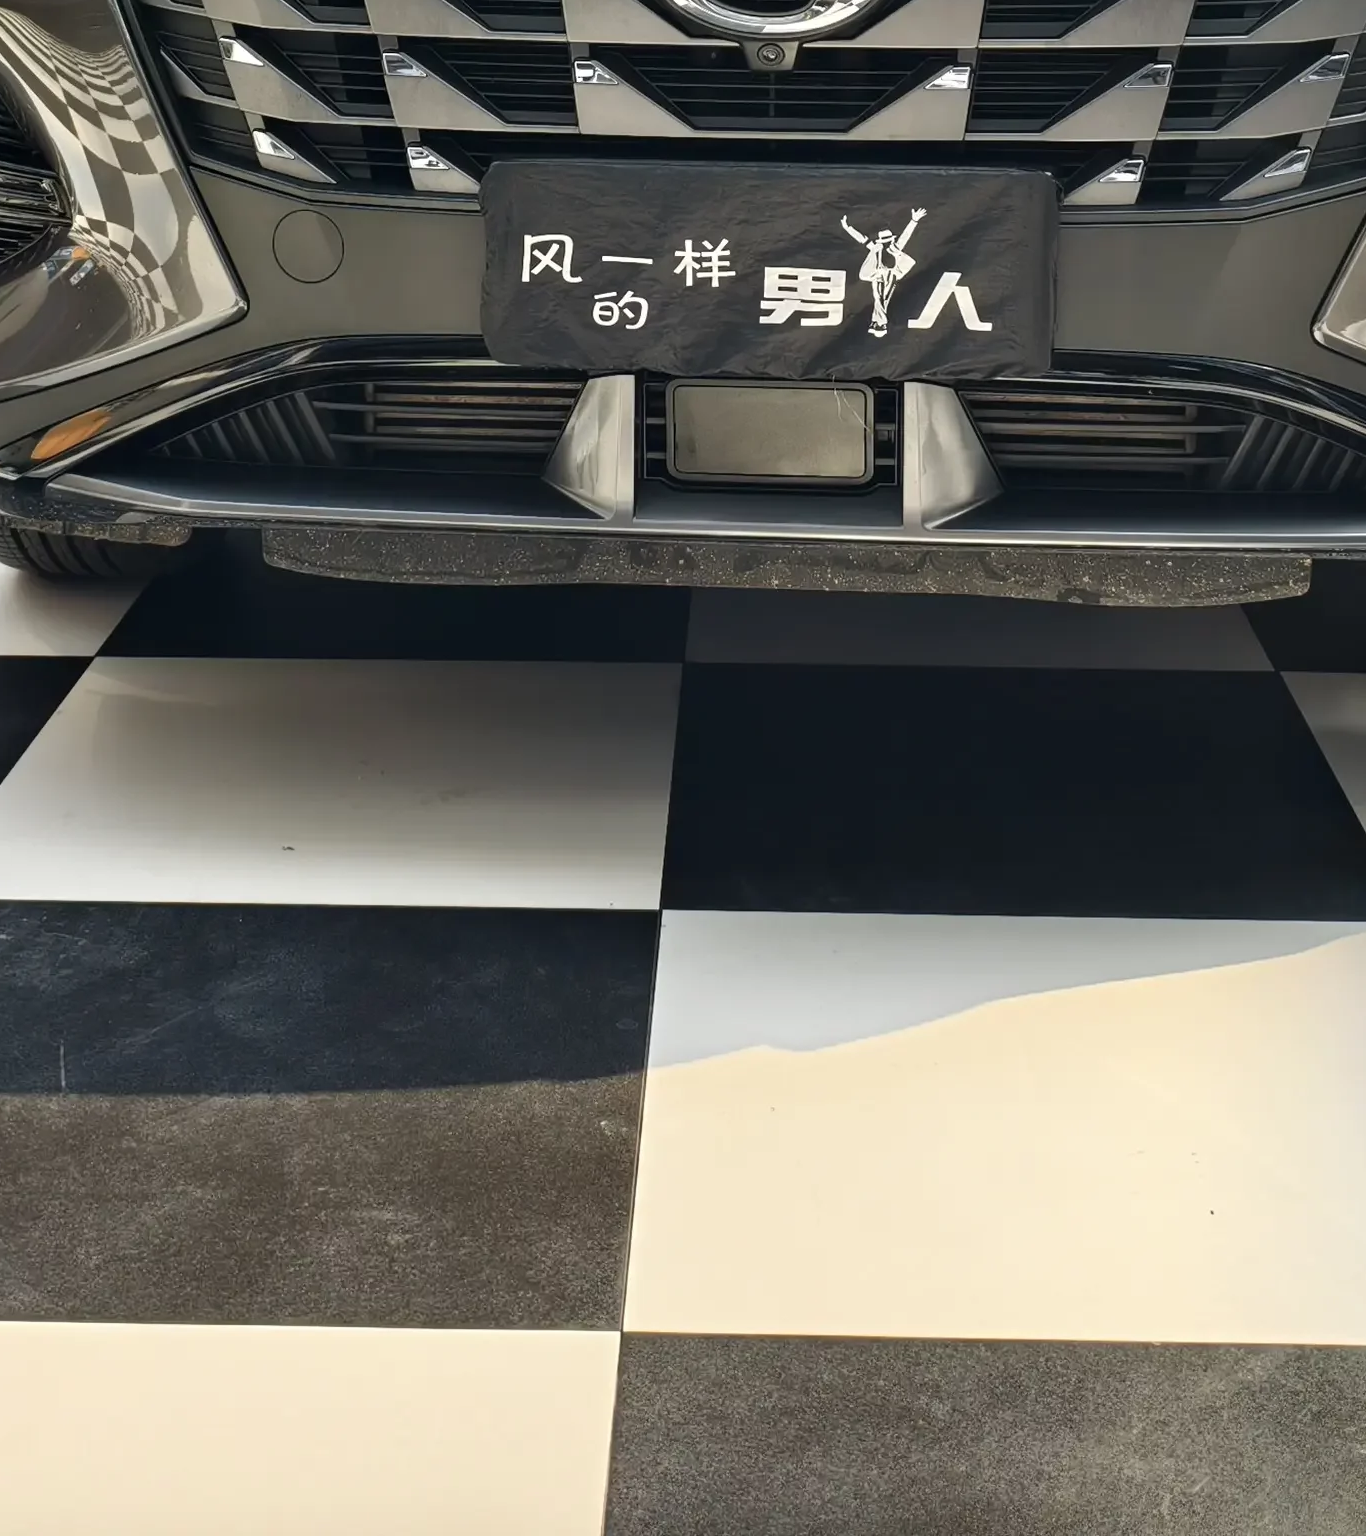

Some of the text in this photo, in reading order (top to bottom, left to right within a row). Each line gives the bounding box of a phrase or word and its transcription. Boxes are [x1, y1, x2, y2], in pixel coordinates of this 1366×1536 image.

[521, 234, 736, 288] 风一样
[593, 291, 648, 330] 的
